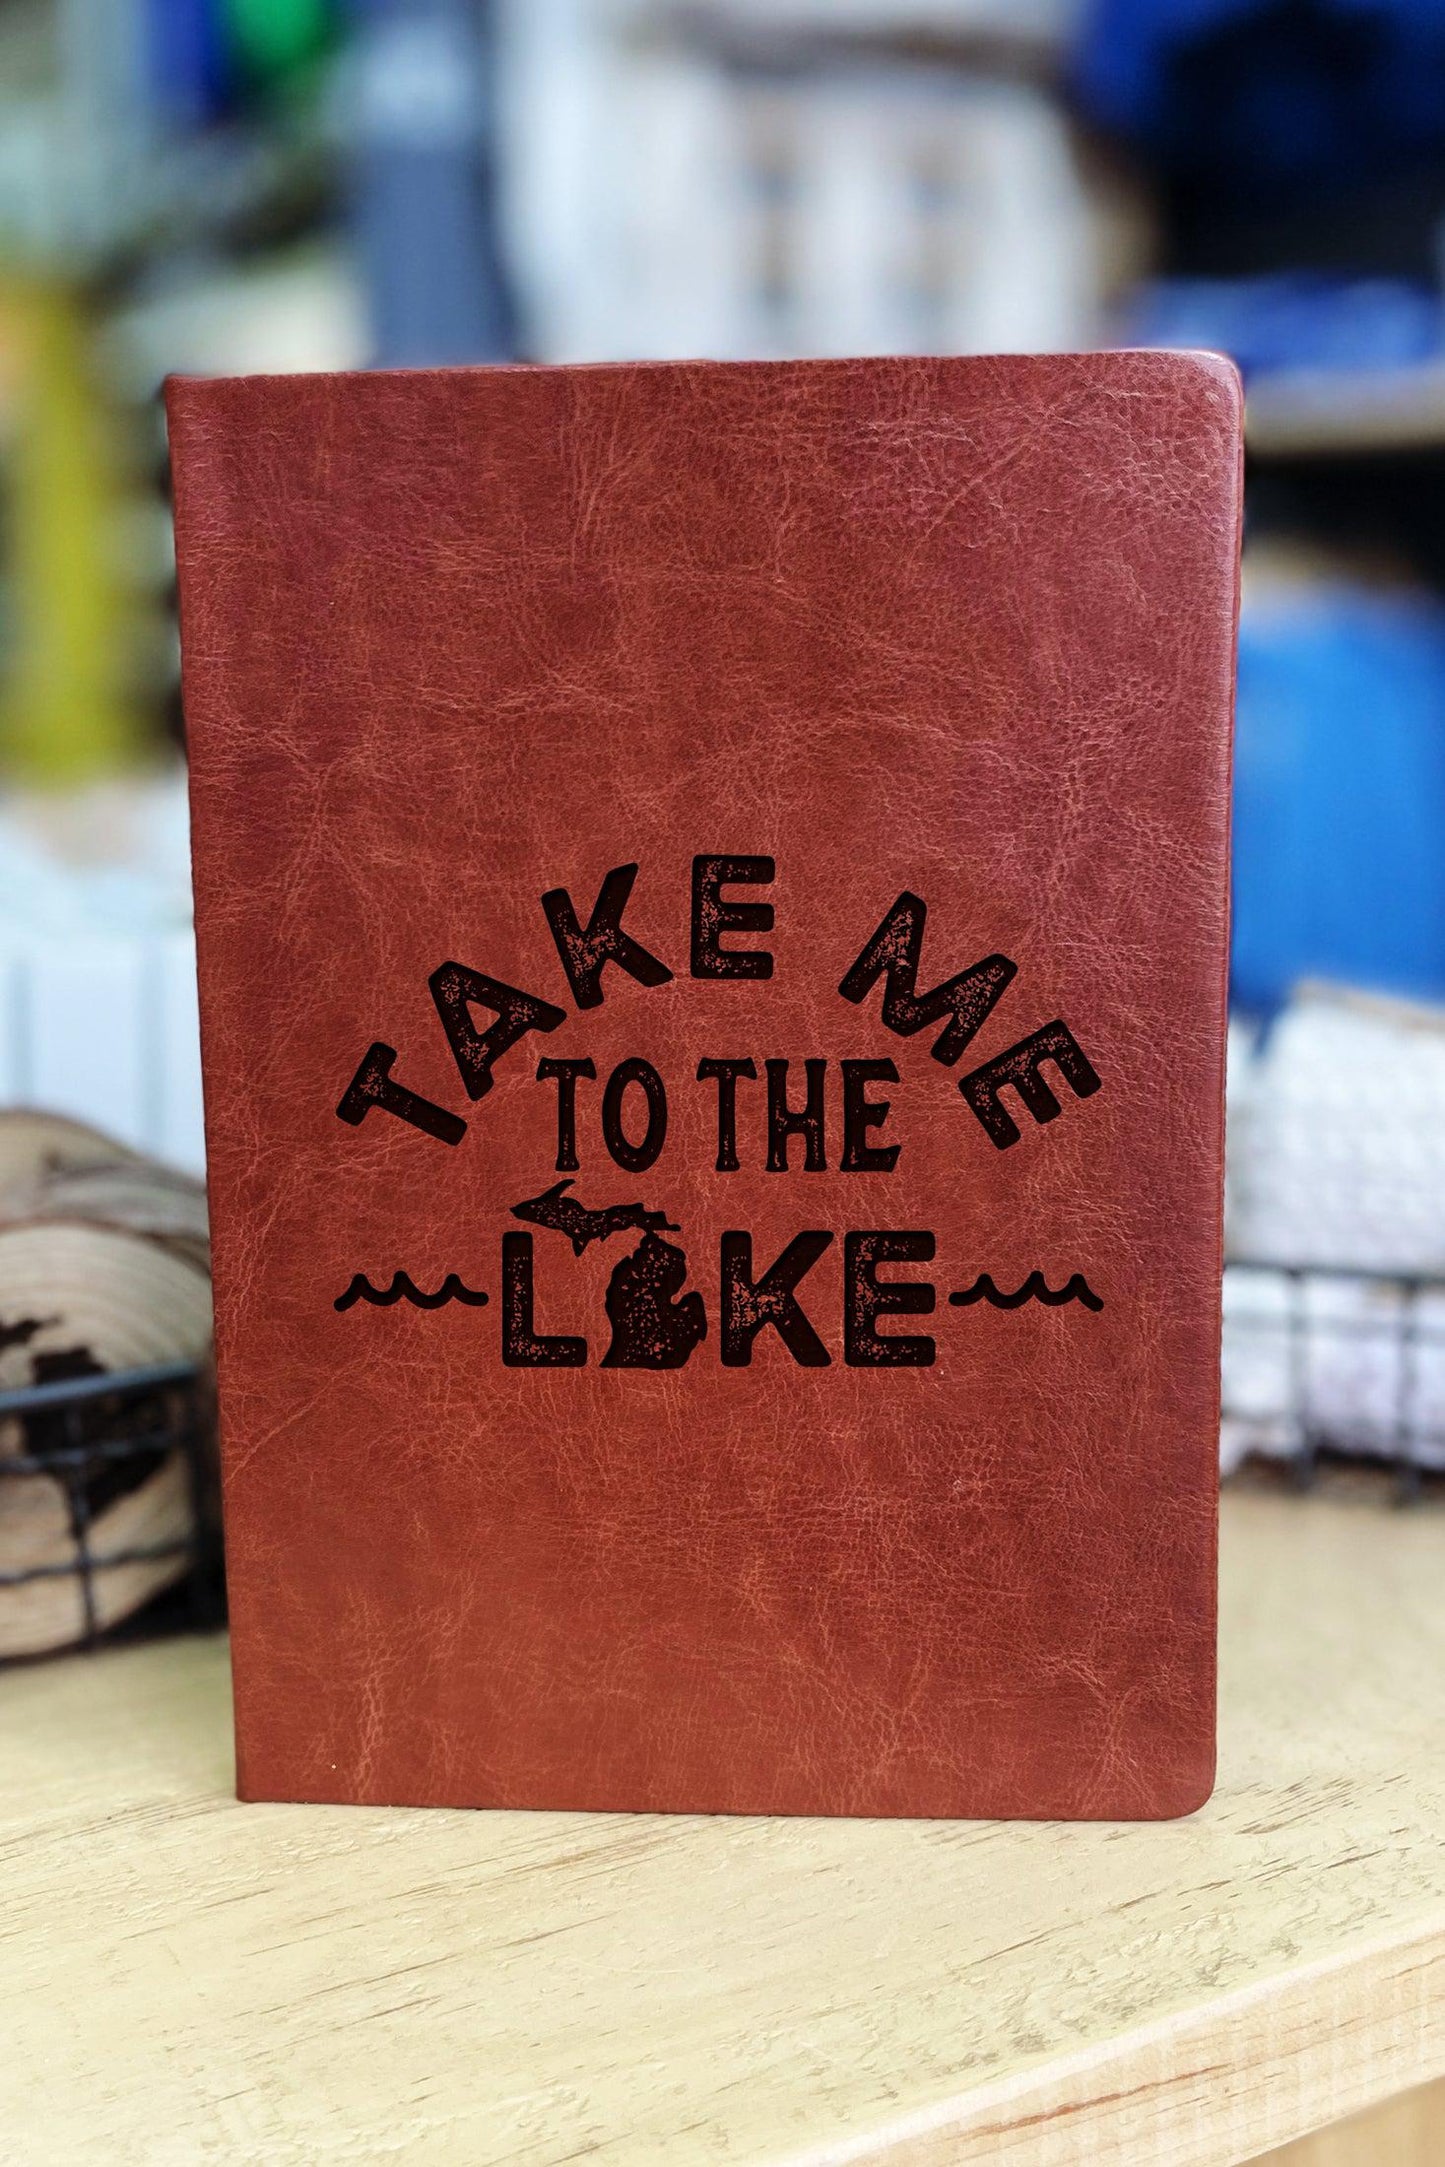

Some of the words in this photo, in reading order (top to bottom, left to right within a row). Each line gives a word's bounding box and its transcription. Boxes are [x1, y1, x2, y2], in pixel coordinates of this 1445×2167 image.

[335, 854, 776, 1147] TAKE
[837, 890, 1102, 1151] ME
[535, 1056, 668, 1173] TO
[696, 1056, 902, 1173] THE
[501, 1229, 937, 1371] LKE
